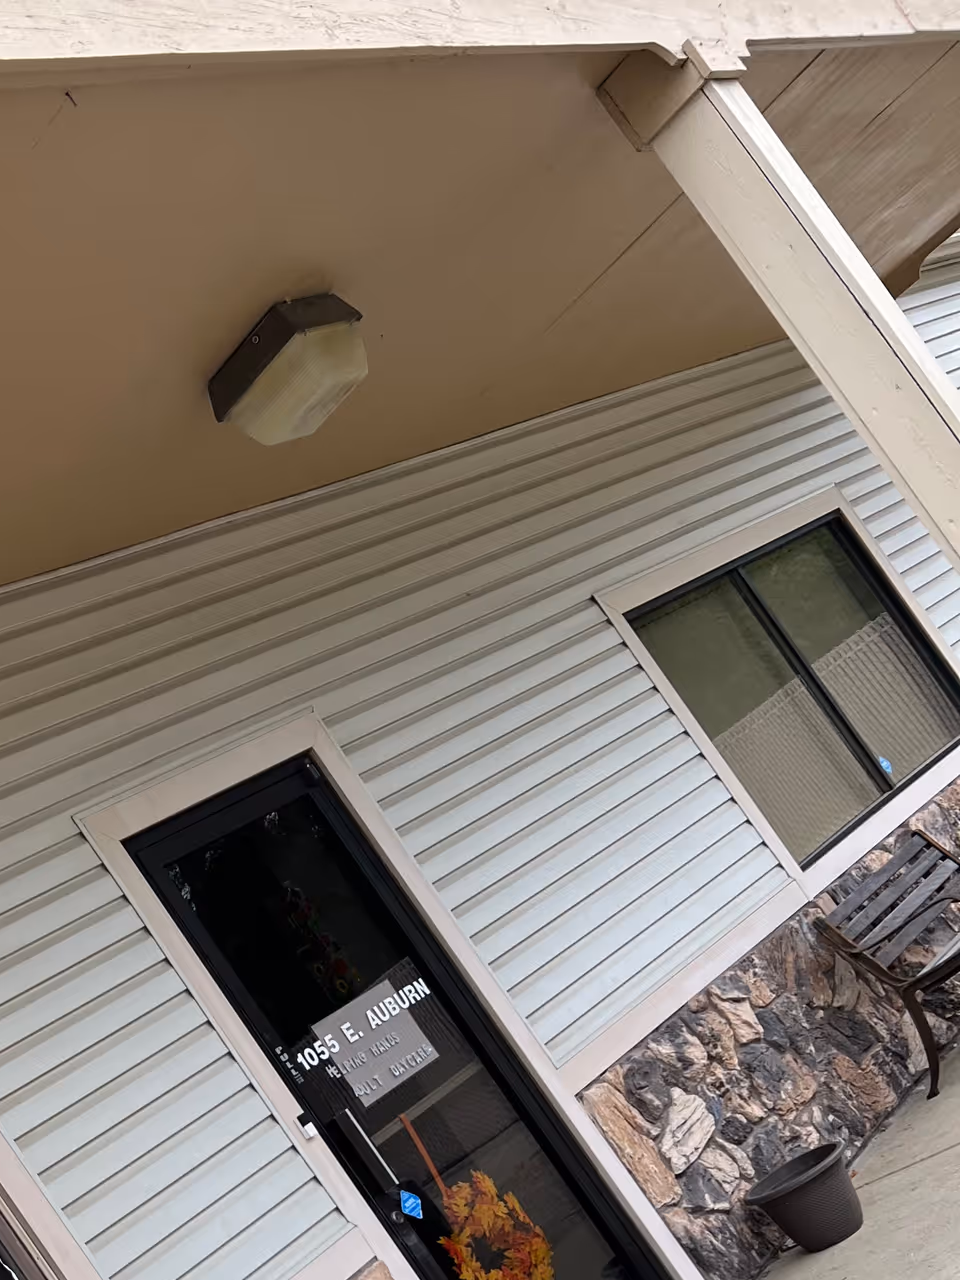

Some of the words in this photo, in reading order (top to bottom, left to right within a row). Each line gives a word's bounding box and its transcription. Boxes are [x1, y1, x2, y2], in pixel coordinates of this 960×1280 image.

[297, 1034, 340, 1070] 1055
[341, 1022, 364, 1043] E.
[366, 978, 430, 1029] AUBURN
[325, 1052, 367, 1078] HELPING
[370, 1032, 400, 1056] HANDS
